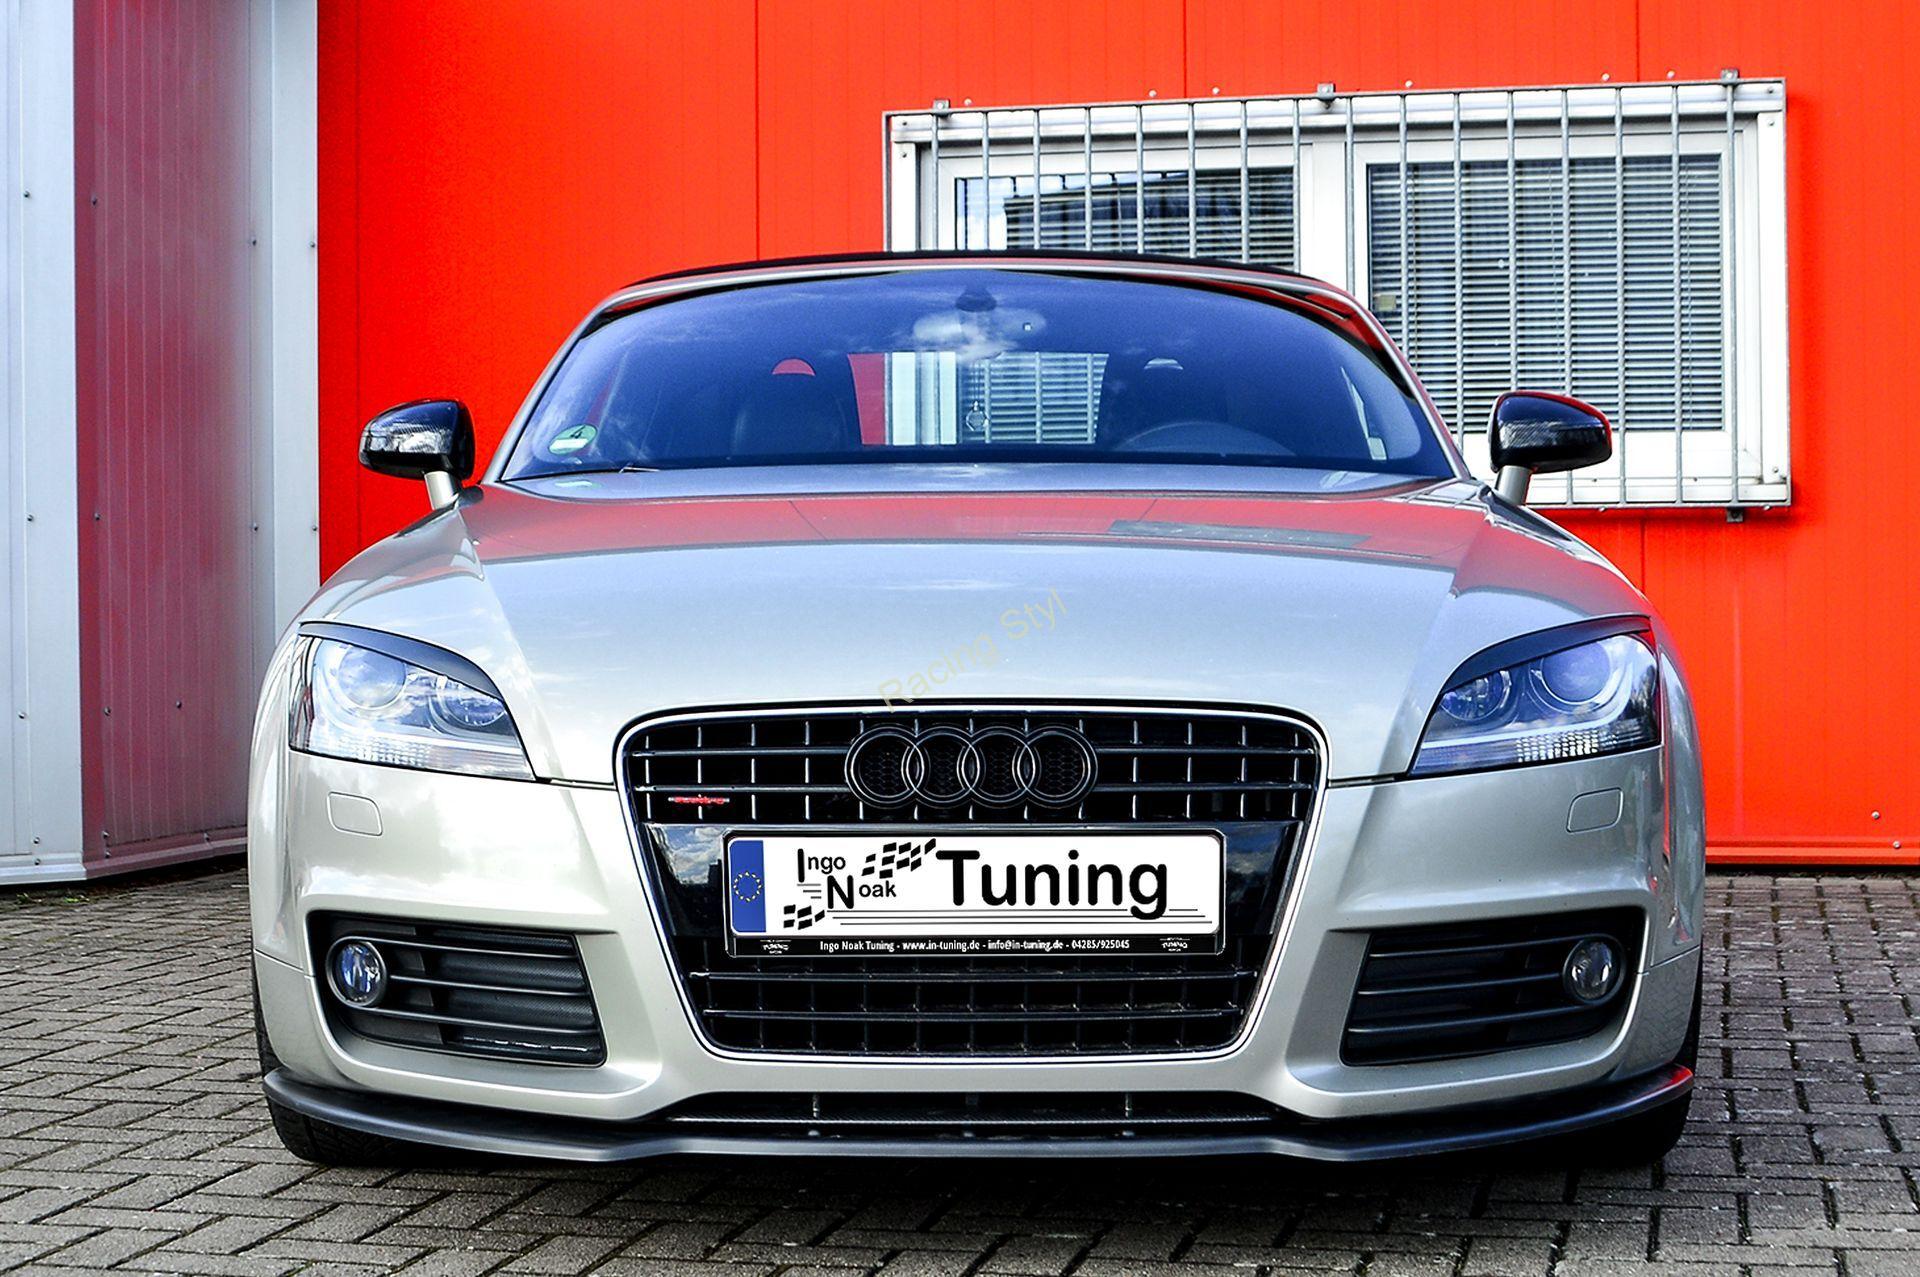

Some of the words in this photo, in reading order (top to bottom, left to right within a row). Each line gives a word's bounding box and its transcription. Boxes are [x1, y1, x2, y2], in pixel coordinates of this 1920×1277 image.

[797, 848, 846, 883] Ingo
[826, 874, 897, 909] Noak
[935, 849, 1167, 920] Tuning
[820, 940, 840, 953] Ingo
[841, 940, 865, 951] Noak
[865, 940, 895, 953] Tuning
[902, 940, 980, 952] www.in-tuning.de
[987, 939, 1064, 952] info@in-tuning.de
